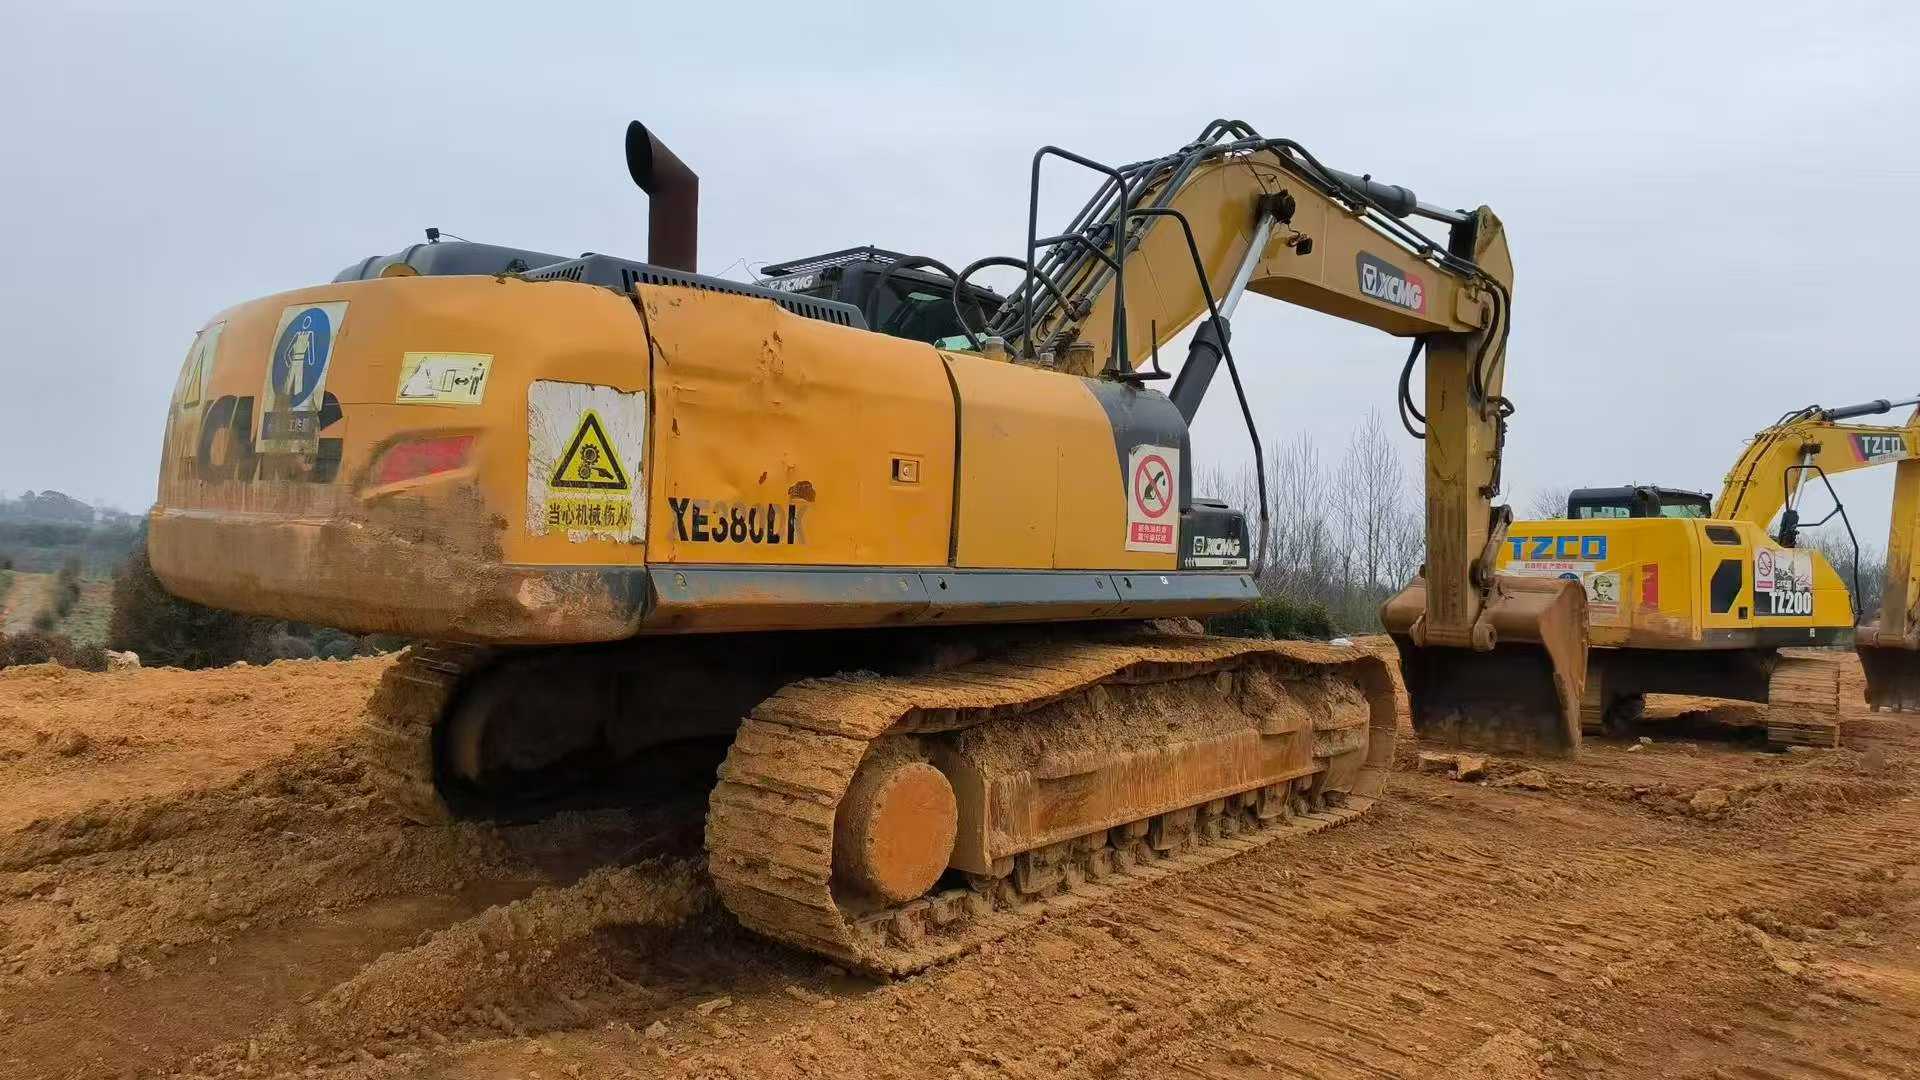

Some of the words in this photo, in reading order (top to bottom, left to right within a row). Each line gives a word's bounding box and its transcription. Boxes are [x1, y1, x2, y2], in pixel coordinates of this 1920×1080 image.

[1376, 271, 1422, 309] XCMG
[549, 502, 628, 526] 当心机械伤人
[1204, 537, 1240, 556] XCMG
[1507, 535, 1607, 560] TZCO
[1769, 591, 1812, 614] TZ200
